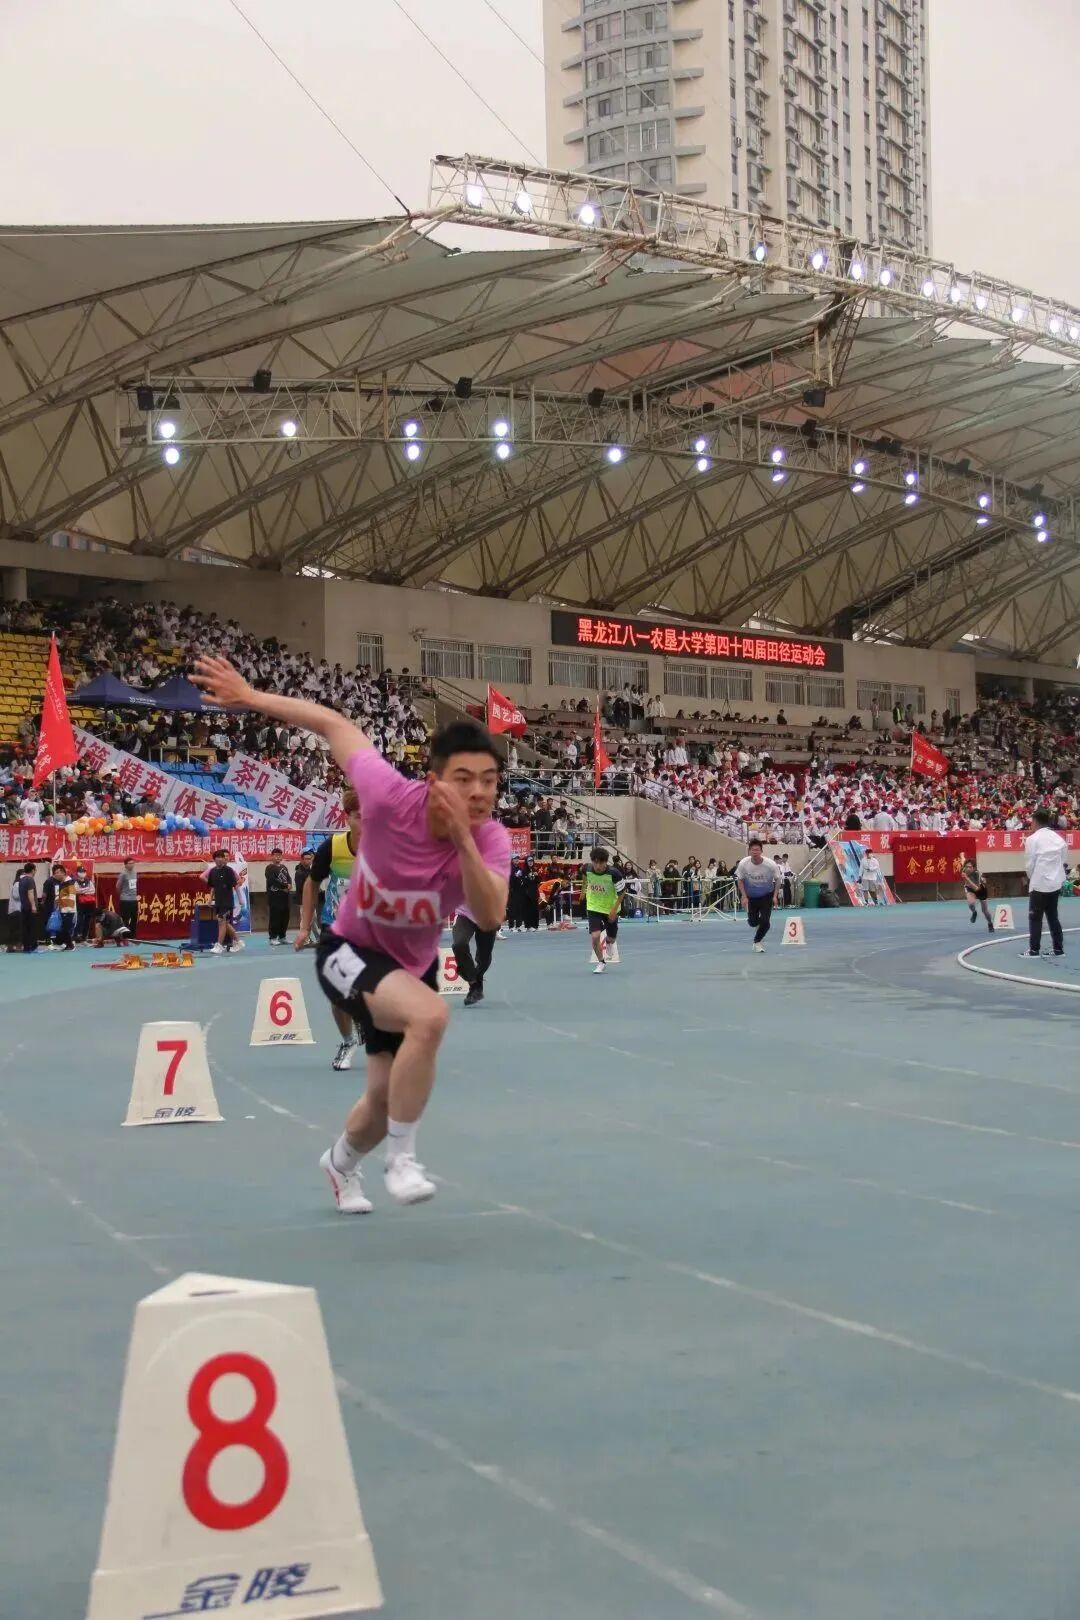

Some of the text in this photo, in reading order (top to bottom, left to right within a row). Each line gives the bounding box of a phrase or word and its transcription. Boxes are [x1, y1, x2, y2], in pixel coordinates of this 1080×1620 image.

[578, 617, 826, 666] 黑龙江八一农垦大学第四十四届田径运动会
[264, 784, 317, 828] 奕雷
[788, 921, 798, 938] 3
[999, 908, 1008, 922] 2
[443, 956, 459, 981] 5
[269, 990, 293, 1027] 6
[156, 1039, 188, 1096] 7
[181, 1350, 290, 1532] 8
[179, 1562, 311, 1612] 金陵
